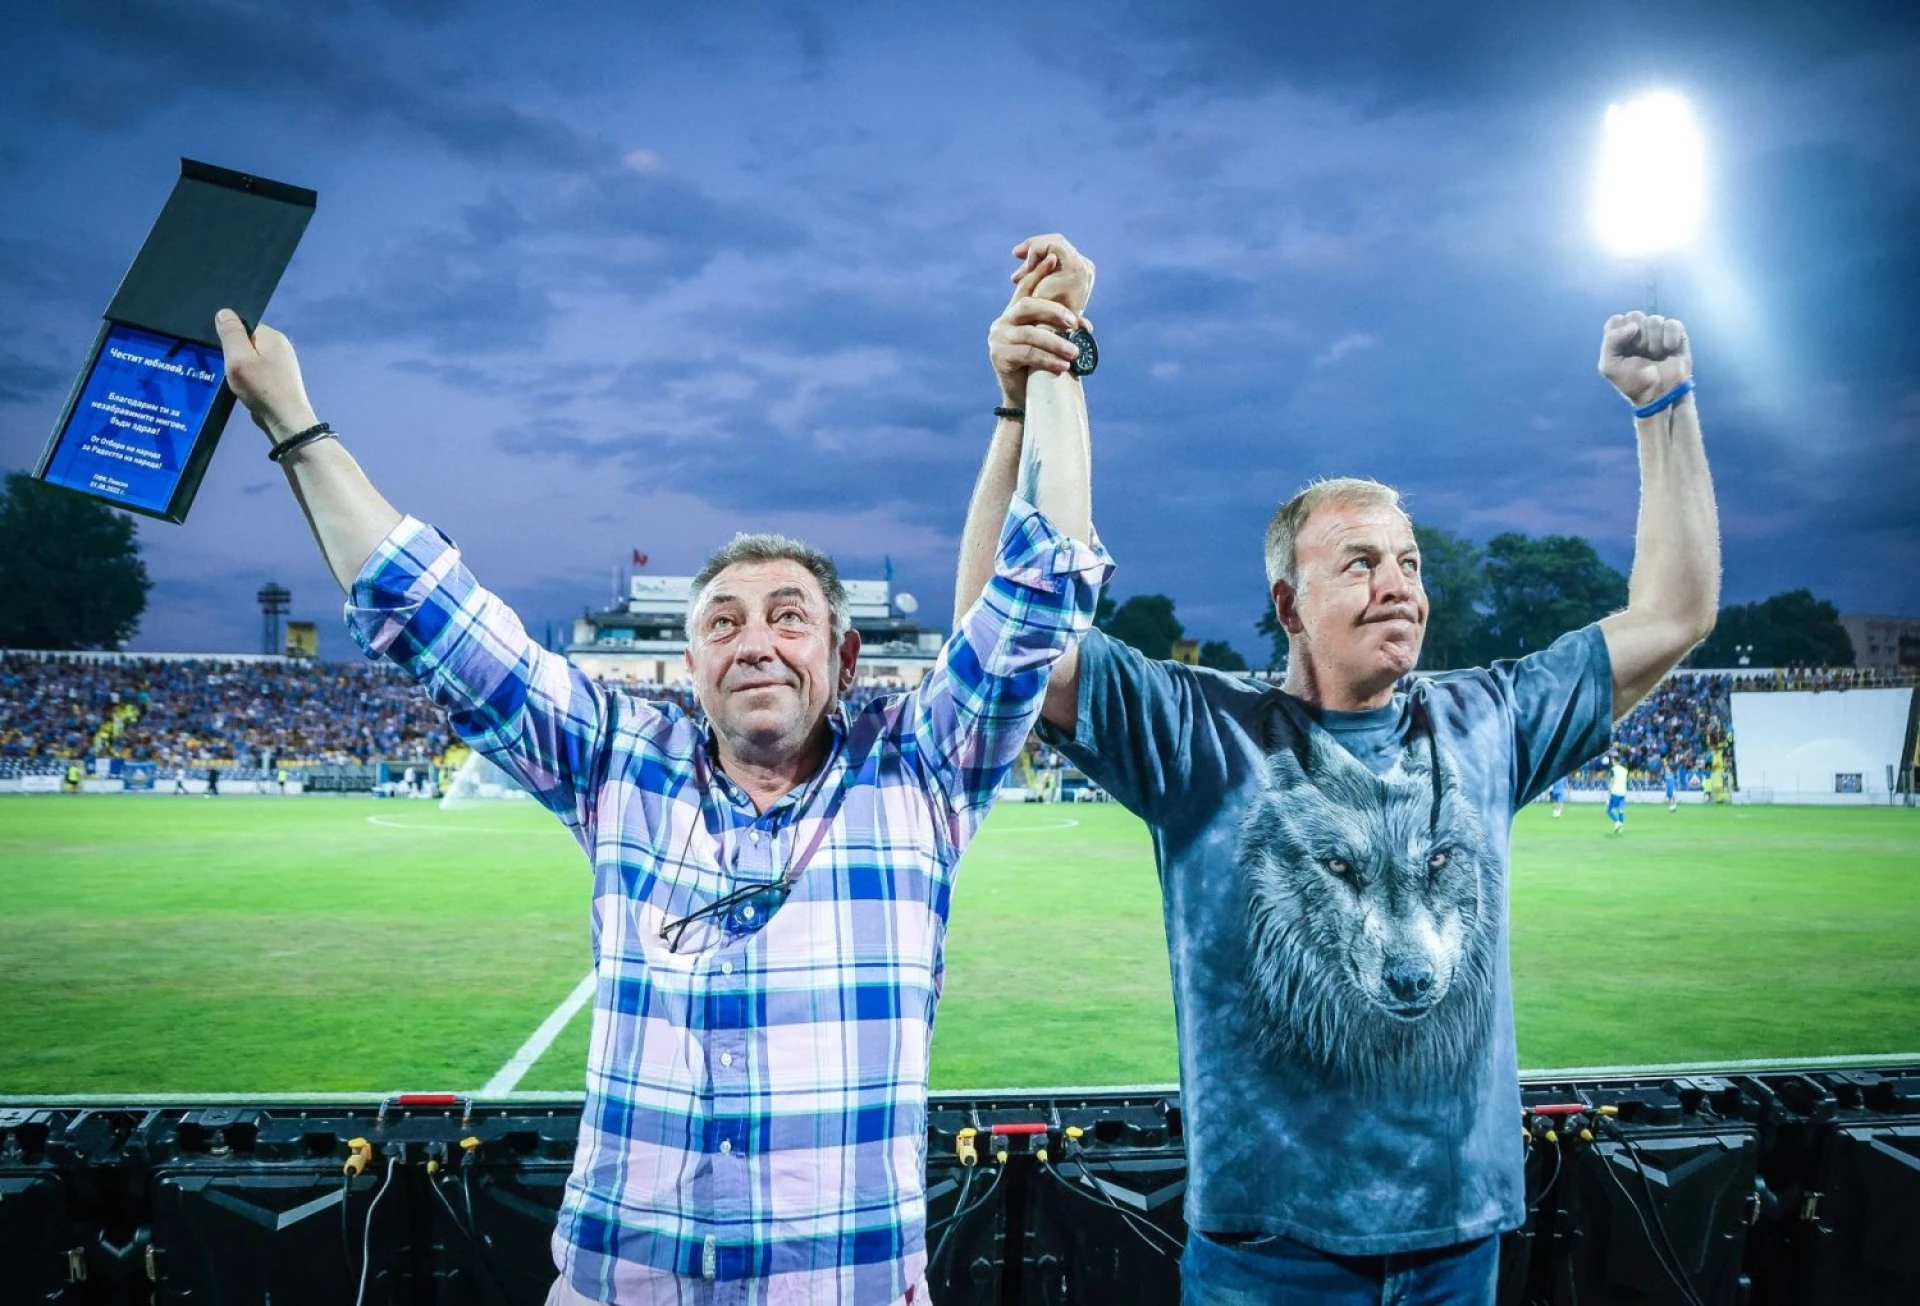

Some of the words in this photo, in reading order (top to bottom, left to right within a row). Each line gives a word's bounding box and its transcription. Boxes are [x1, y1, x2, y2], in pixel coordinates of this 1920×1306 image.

[110, 347, 144, 364] Честит
[143, 357, 184, 376] юбилей,
[108, 392, 159, 411] Благодарим
[159, 406, 169, 414] ти
[170, 409, 181, 417] за
[91, 401, 155, 422] незабравимите
[155, 416, 188, 432] мигове,
[109, 416, 131, 429] бъди
[131, 422, 161, 436] здрав!
[90, 434, 101, 443] От
[124, 455, 133, 463] на
